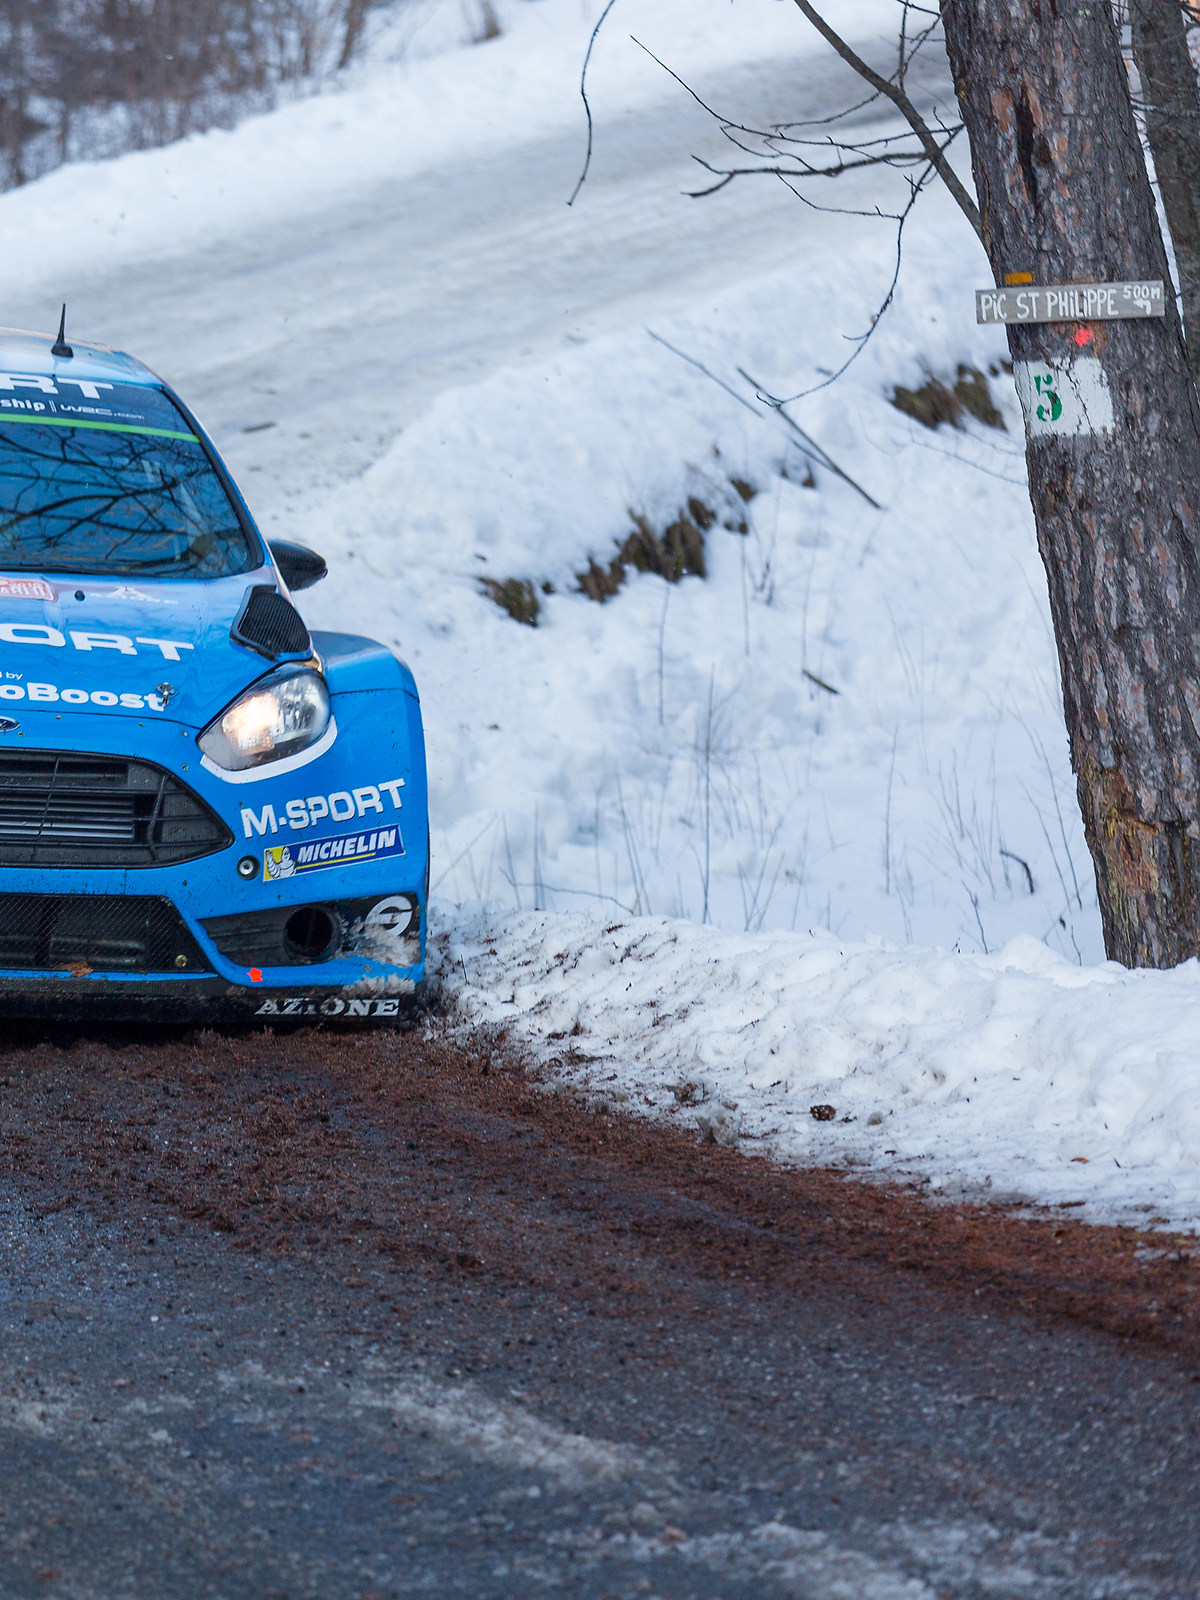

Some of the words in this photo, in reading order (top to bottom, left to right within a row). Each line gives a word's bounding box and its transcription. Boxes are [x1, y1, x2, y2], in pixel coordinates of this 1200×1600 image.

[1016, 292, 1040, 319] ST
[1033, 373, 1063, 422] 5
[5, 671, 23, 681] by
[240, 778, 406, 838] M-SPORT
[297, 828, 396, 863] MICHELIN
